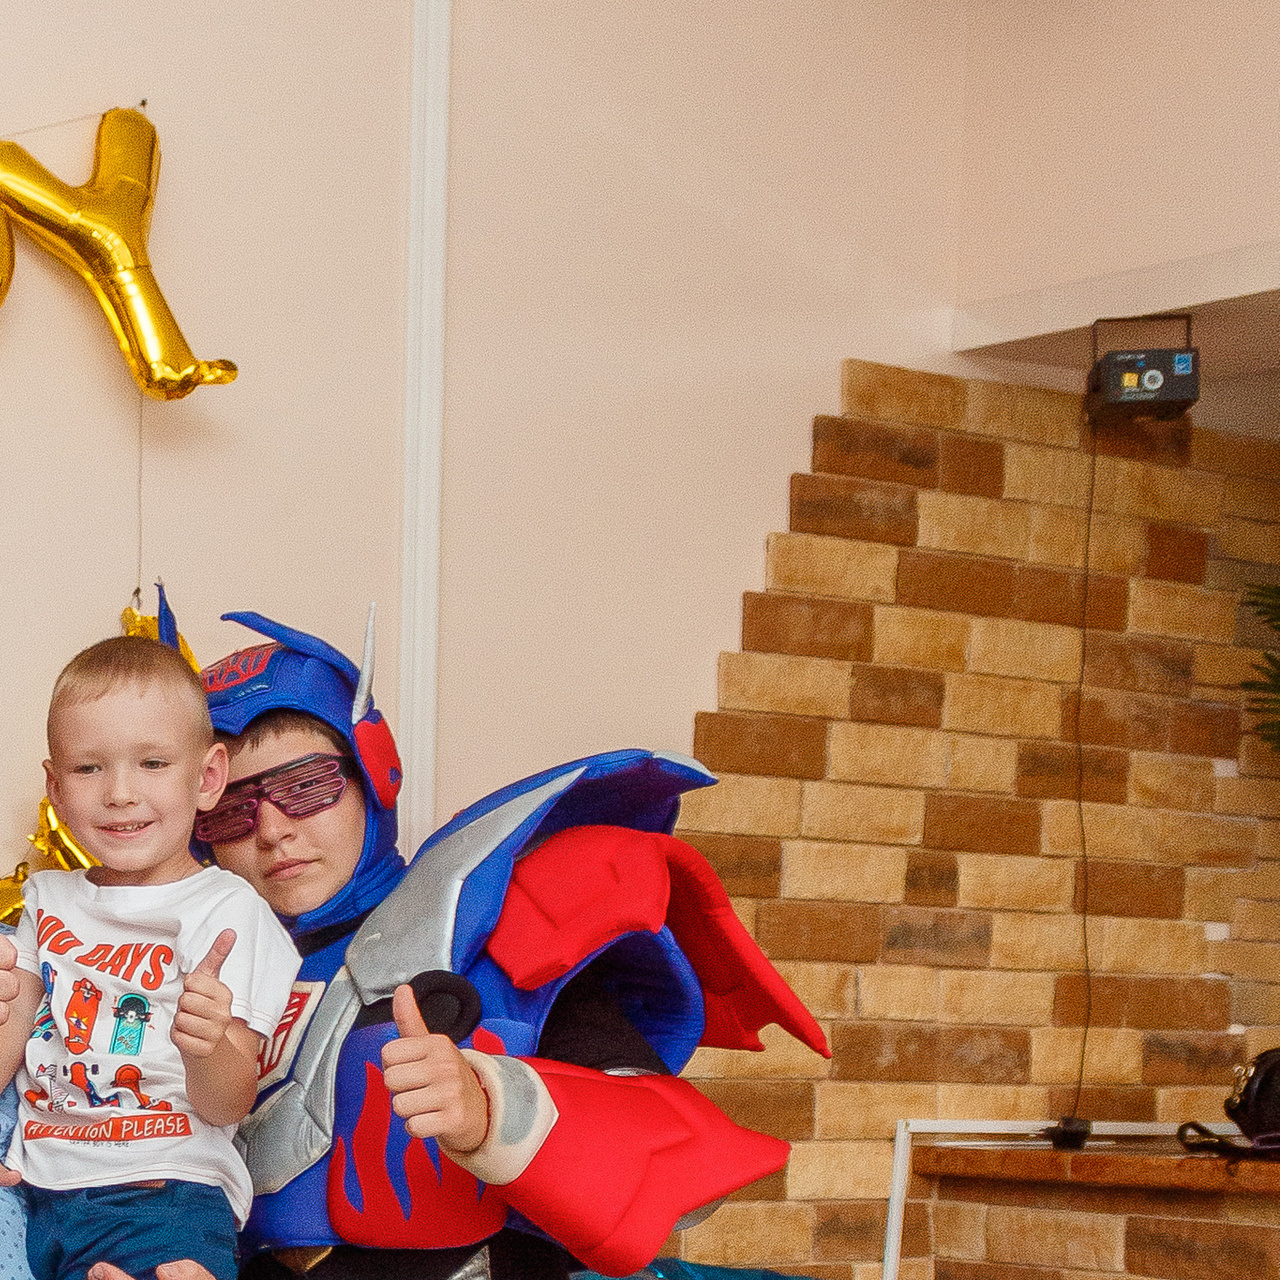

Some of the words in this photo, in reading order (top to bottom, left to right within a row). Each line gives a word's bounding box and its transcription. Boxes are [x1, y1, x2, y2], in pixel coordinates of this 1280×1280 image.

[74, 942, 174, 991] DAYS
[27, 1120, 113, 1139] ATTENTION
[121, 1115, 186, 1139] PLEASE
